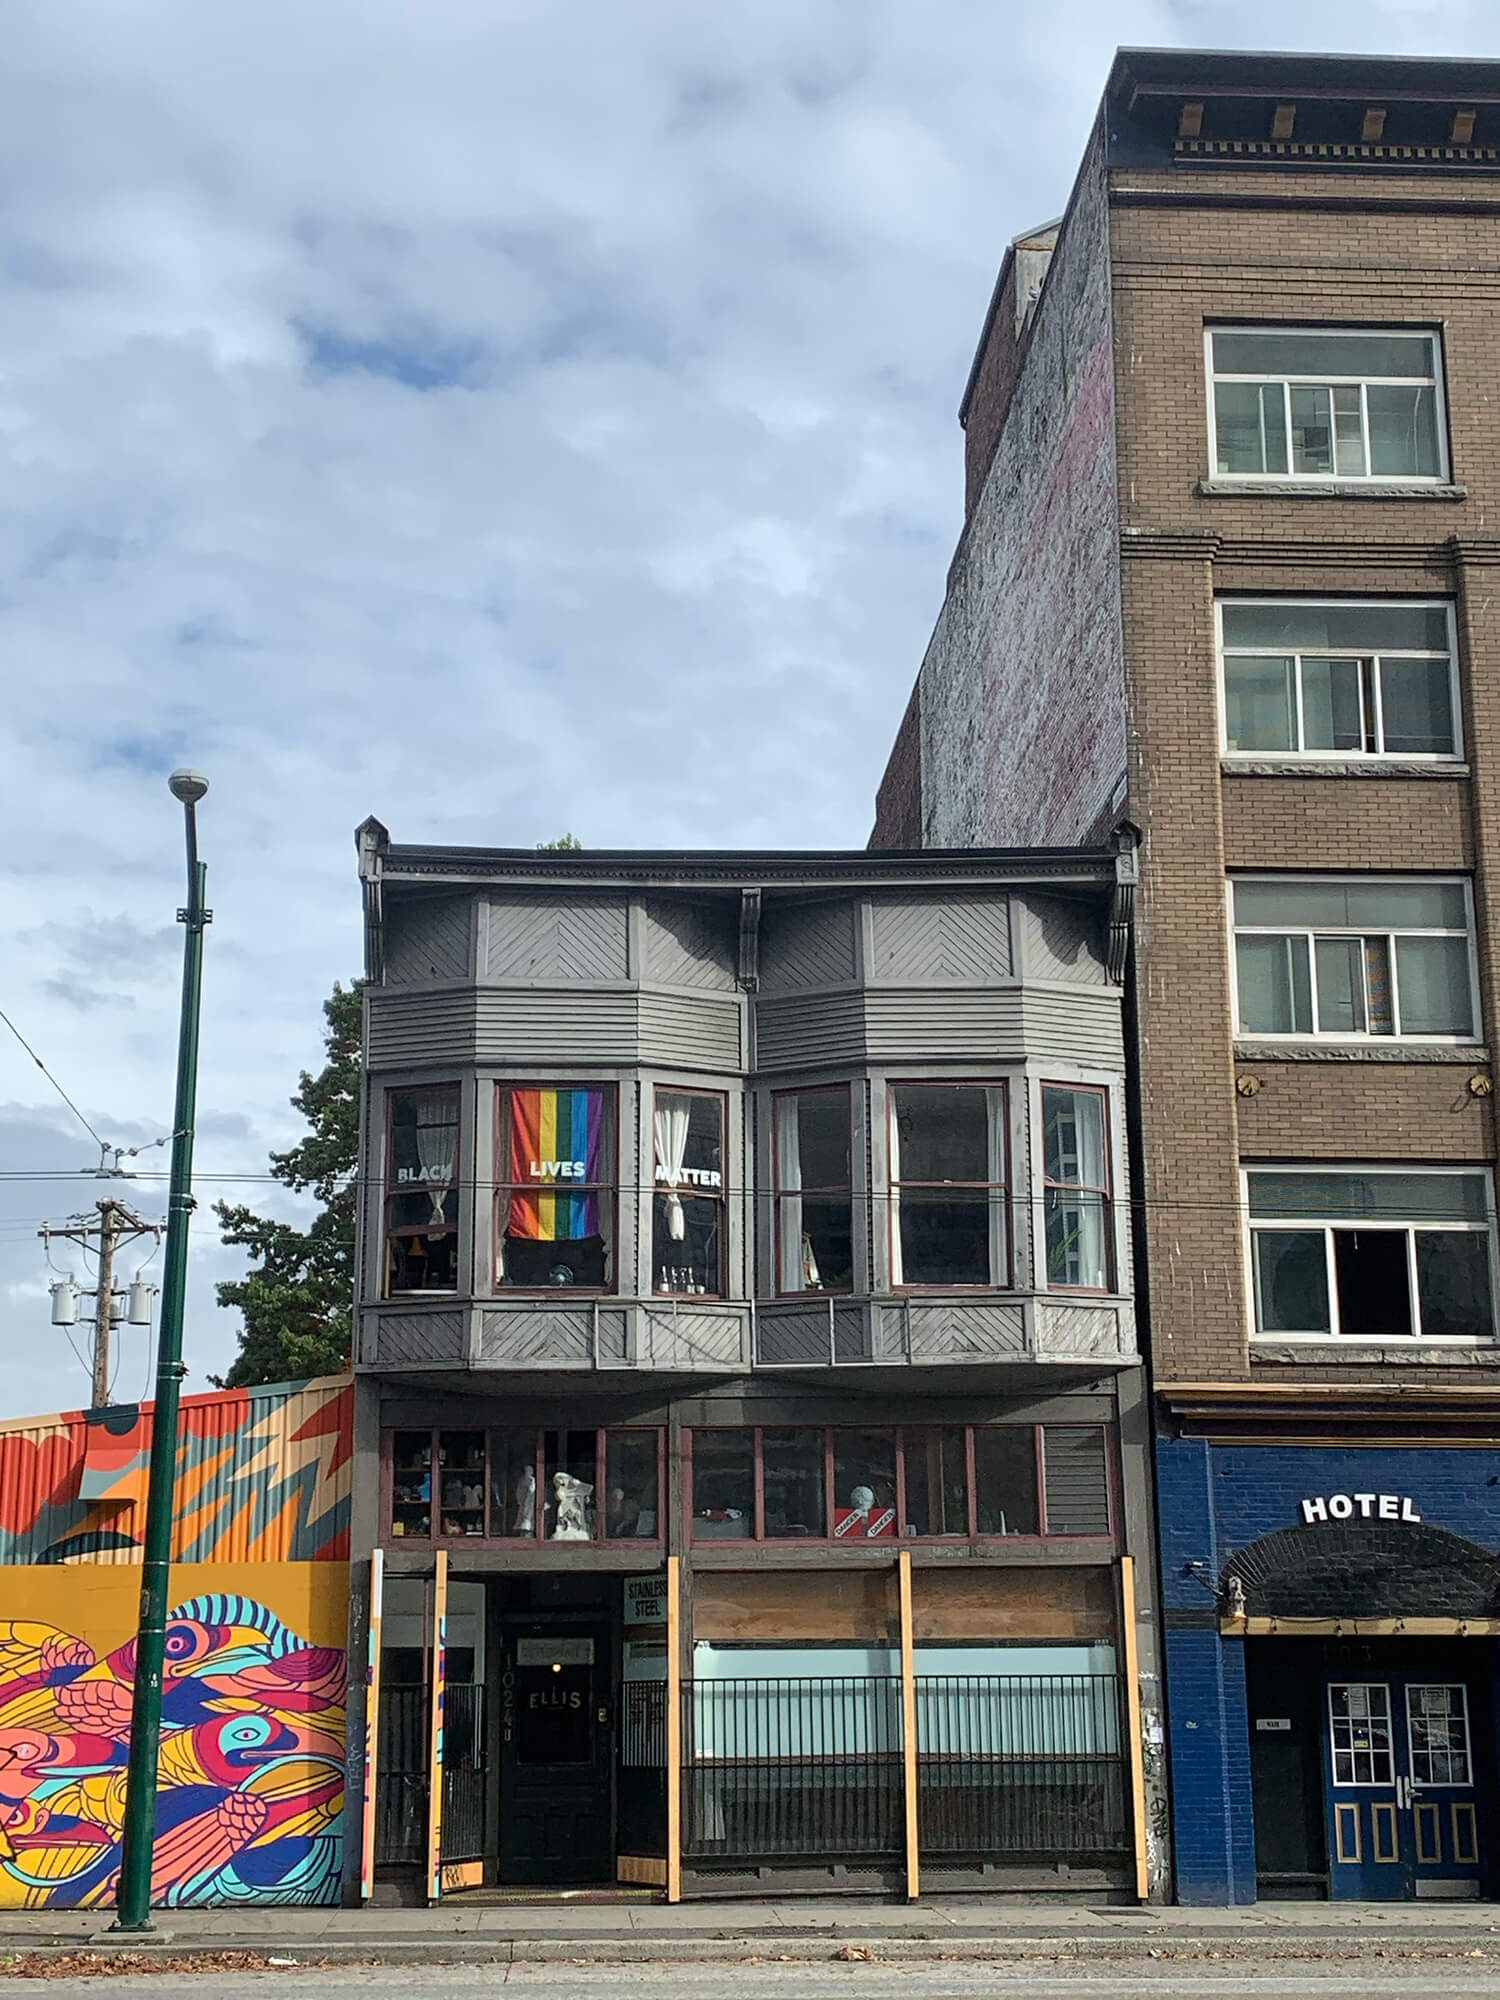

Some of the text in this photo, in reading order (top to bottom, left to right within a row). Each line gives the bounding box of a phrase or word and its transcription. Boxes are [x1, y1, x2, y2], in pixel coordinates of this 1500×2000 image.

[397, 1161, 721, 1186] BLACK LIVES MATTER
[1302, 1494, 1421, 1523] HOTEL
[836, 1512, 859, 1535] DANGER
[870, 1512, 893, 1535] DANGER
[635, 1600, 661, 1616] STEEL
[529, 1685, 582, 1709] ELLIS
